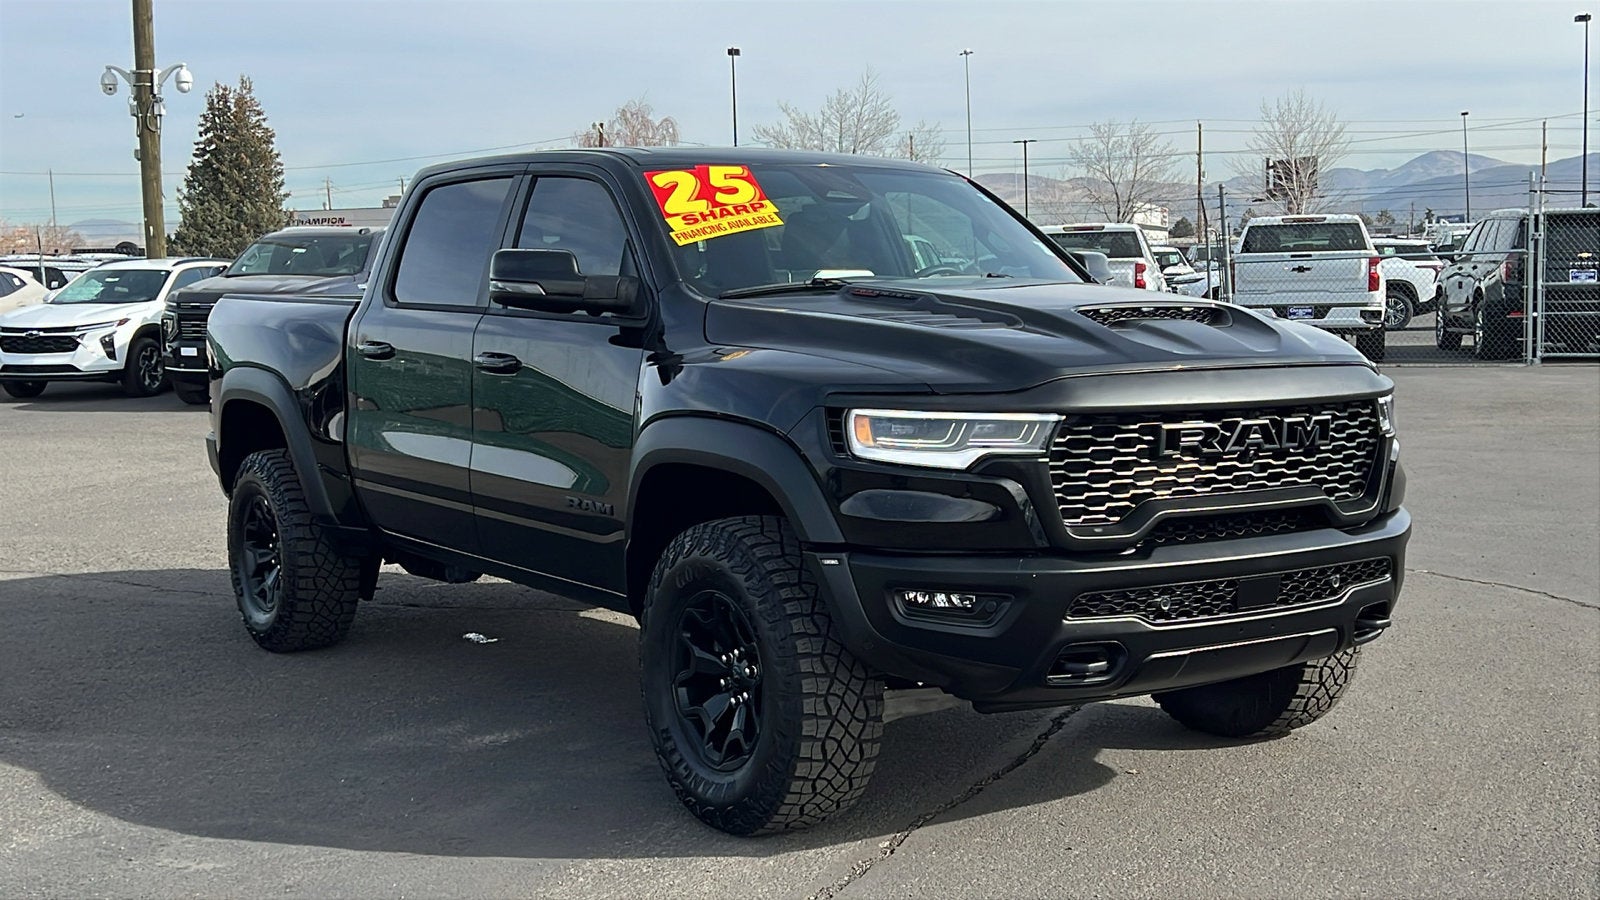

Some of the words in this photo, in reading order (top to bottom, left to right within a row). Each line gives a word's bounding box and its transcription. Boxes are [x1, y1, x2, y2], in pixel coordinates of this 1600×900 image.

[652, 165, 760, 214] 25
[290, 217, 345, 226] HAMPION
[681, 202, 766, 226] SHARP
[674, 222, 727, 242] FINANCING
[727, 214, 778, 230] AVAILABLE
[1159, 415, 1332, 456] RAM
[565, 495, 615, 517] RAM
